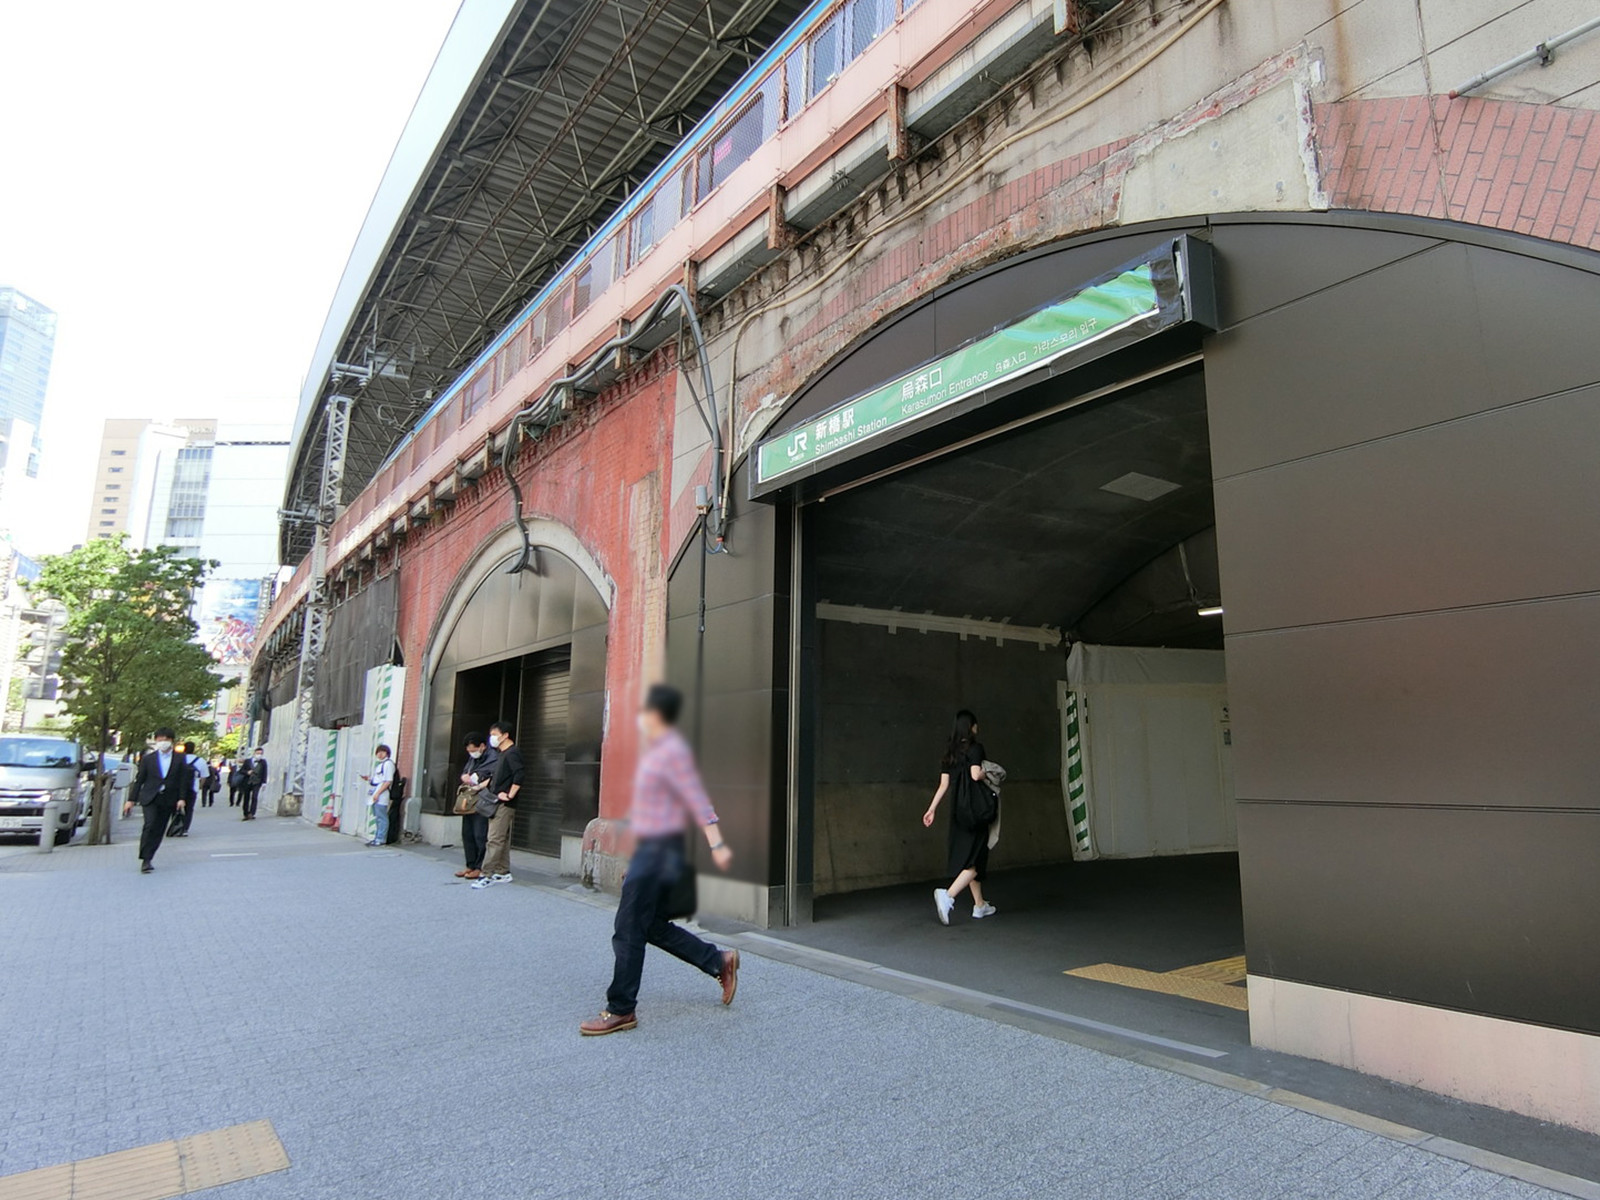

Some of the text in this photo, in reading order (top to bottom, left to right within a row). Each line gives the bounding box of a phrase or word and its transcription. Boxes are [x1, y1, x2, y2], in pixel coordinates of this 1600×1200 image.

[1033, 317, 1097, 355] 가라스모리 입구
[901, 366, 942, 402] 烏森口
[948, 370, 989, 394] Entrance
[815, 407, 855, 441] 新橋駅
[815, 416, 888, 455] Shimbashi Station
[787, 431, 808, 457] JR
